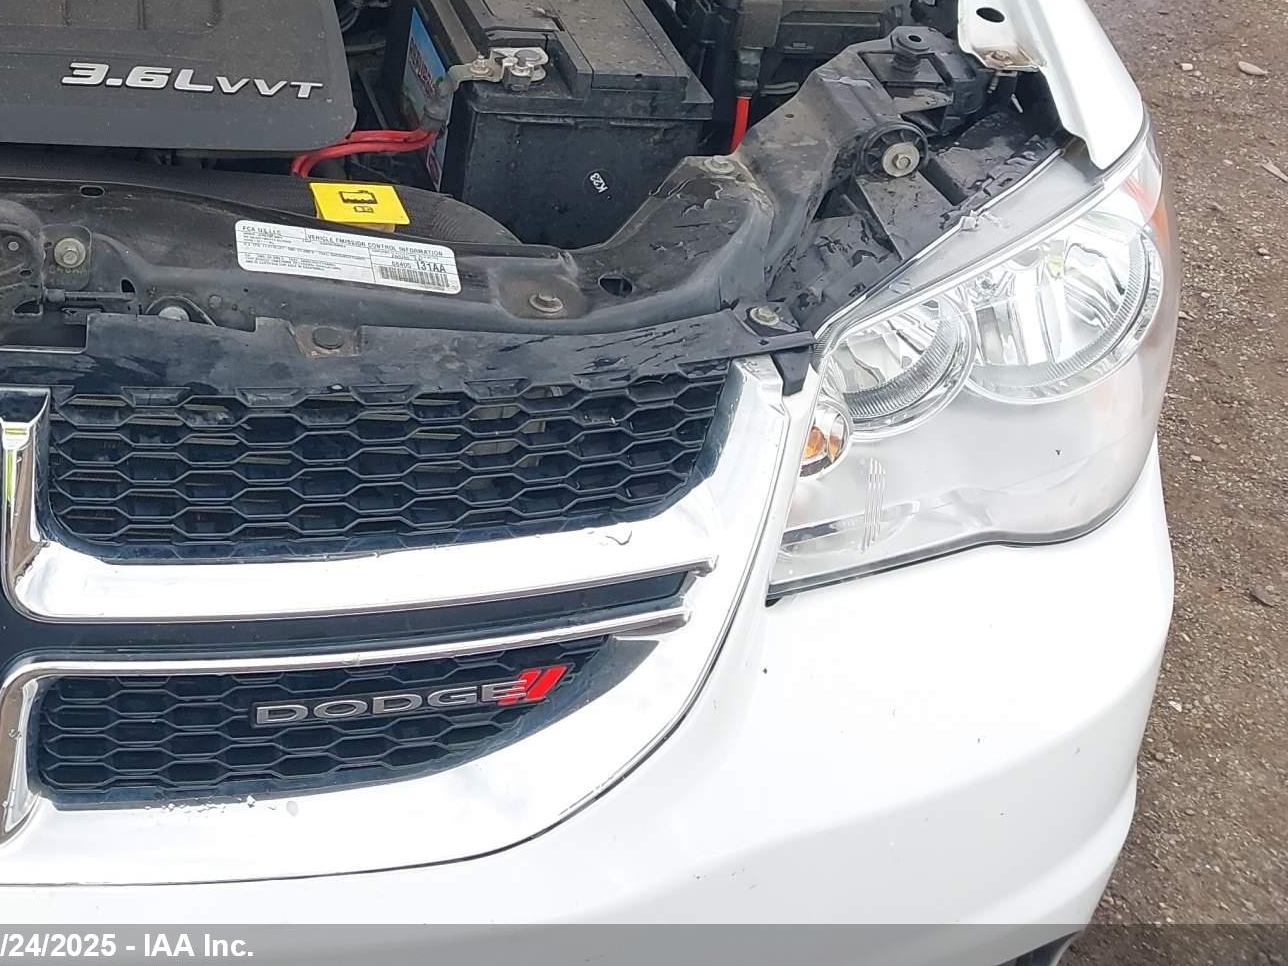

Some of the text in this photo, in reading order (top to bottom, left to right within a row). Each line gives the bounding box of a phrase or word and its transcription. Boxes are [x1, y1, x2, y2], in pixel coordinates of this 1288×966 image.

[590, 173, 608, 192] K23
[307, 234, 334, 243] VEHICLE
[336, 237, 367, 247] EMISSION
[368, 241, 398, 251] CONTROL
[399, 245, 443, 256] INFORMATION
[256, 679, 527, 724] DODGE
